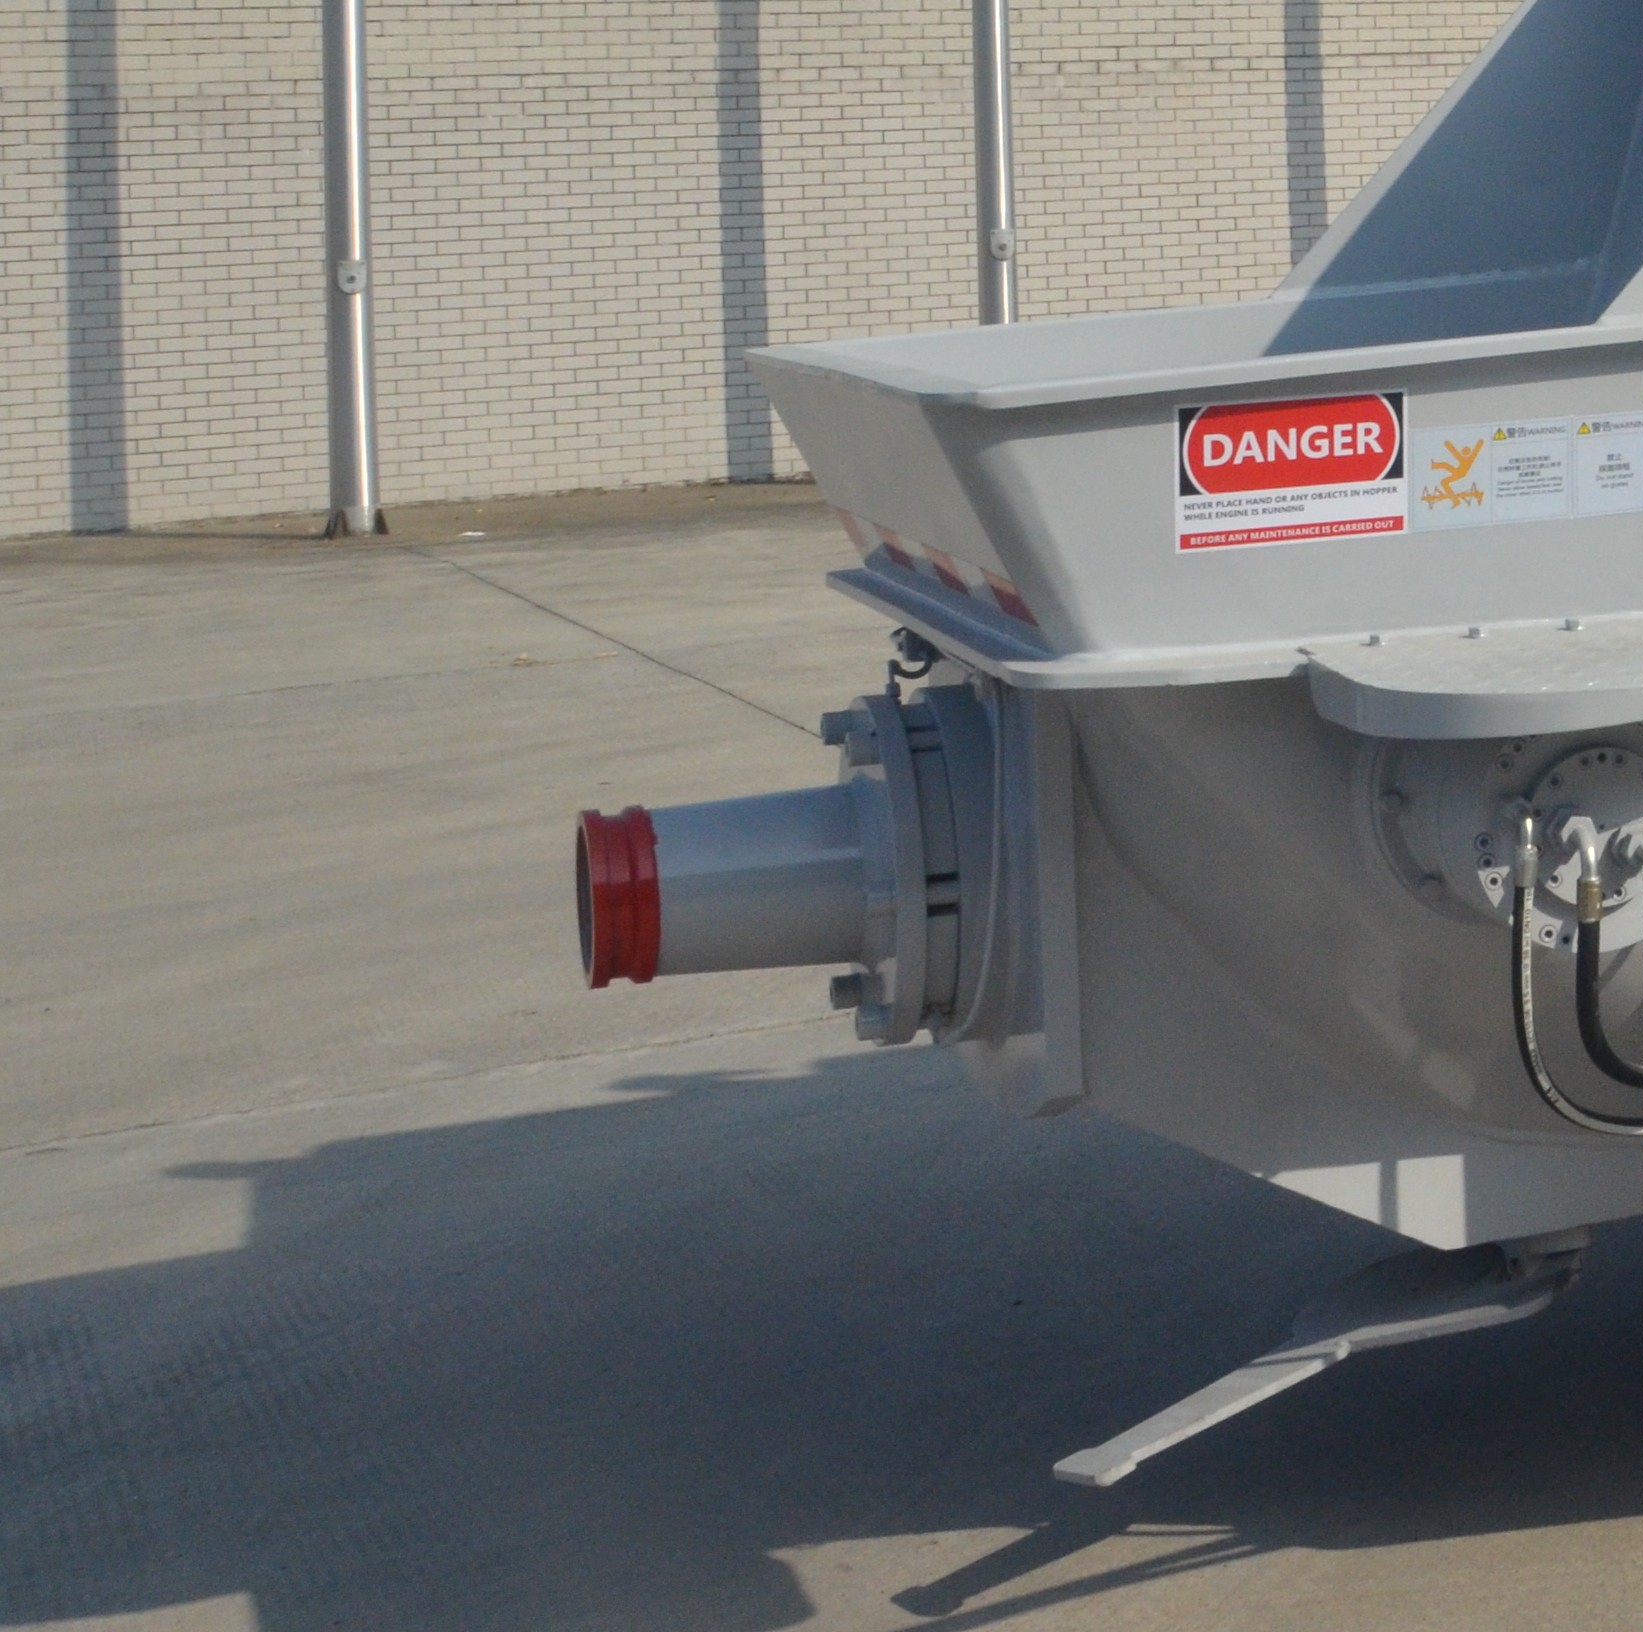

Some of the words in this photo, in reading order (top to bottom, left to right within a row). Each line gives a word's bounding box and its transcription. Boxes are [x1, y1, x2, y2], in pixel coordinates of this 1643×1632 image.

[1203, 422, 1383, 467] DANGER
[1184, 502, 1213, 511] NEVER
[1216, 499, 1242, 508] PLACE
[1246, 496, 1272, 506] HAND
[1275, 495, 1287, 503] OR
[1290, 492, 1309, 502] ANY
[1311, 490, 1348, 500] OBJECTS
[1350, 489, 1360, 497] IN
[1363, 486, 1398, 496] HOPPER
[1184, 512, 1212, 522] WHILE
[1215, 508, 1249, 519] ENGINE
[1251, 507, 1259, 515] IS
[1262, 505, 1305, 515] RUNNING
[1190, 535, 1226, 545] BEFORE
[1228, 533, 1249, 542] ANY
[1251, 527, 1321, 539] MAINTENANCE
[1322, 526, 1331, 534] IS
[1333, 522, 1373, 533] CARRIED
[1374, 520, 1394, 529] OUT
